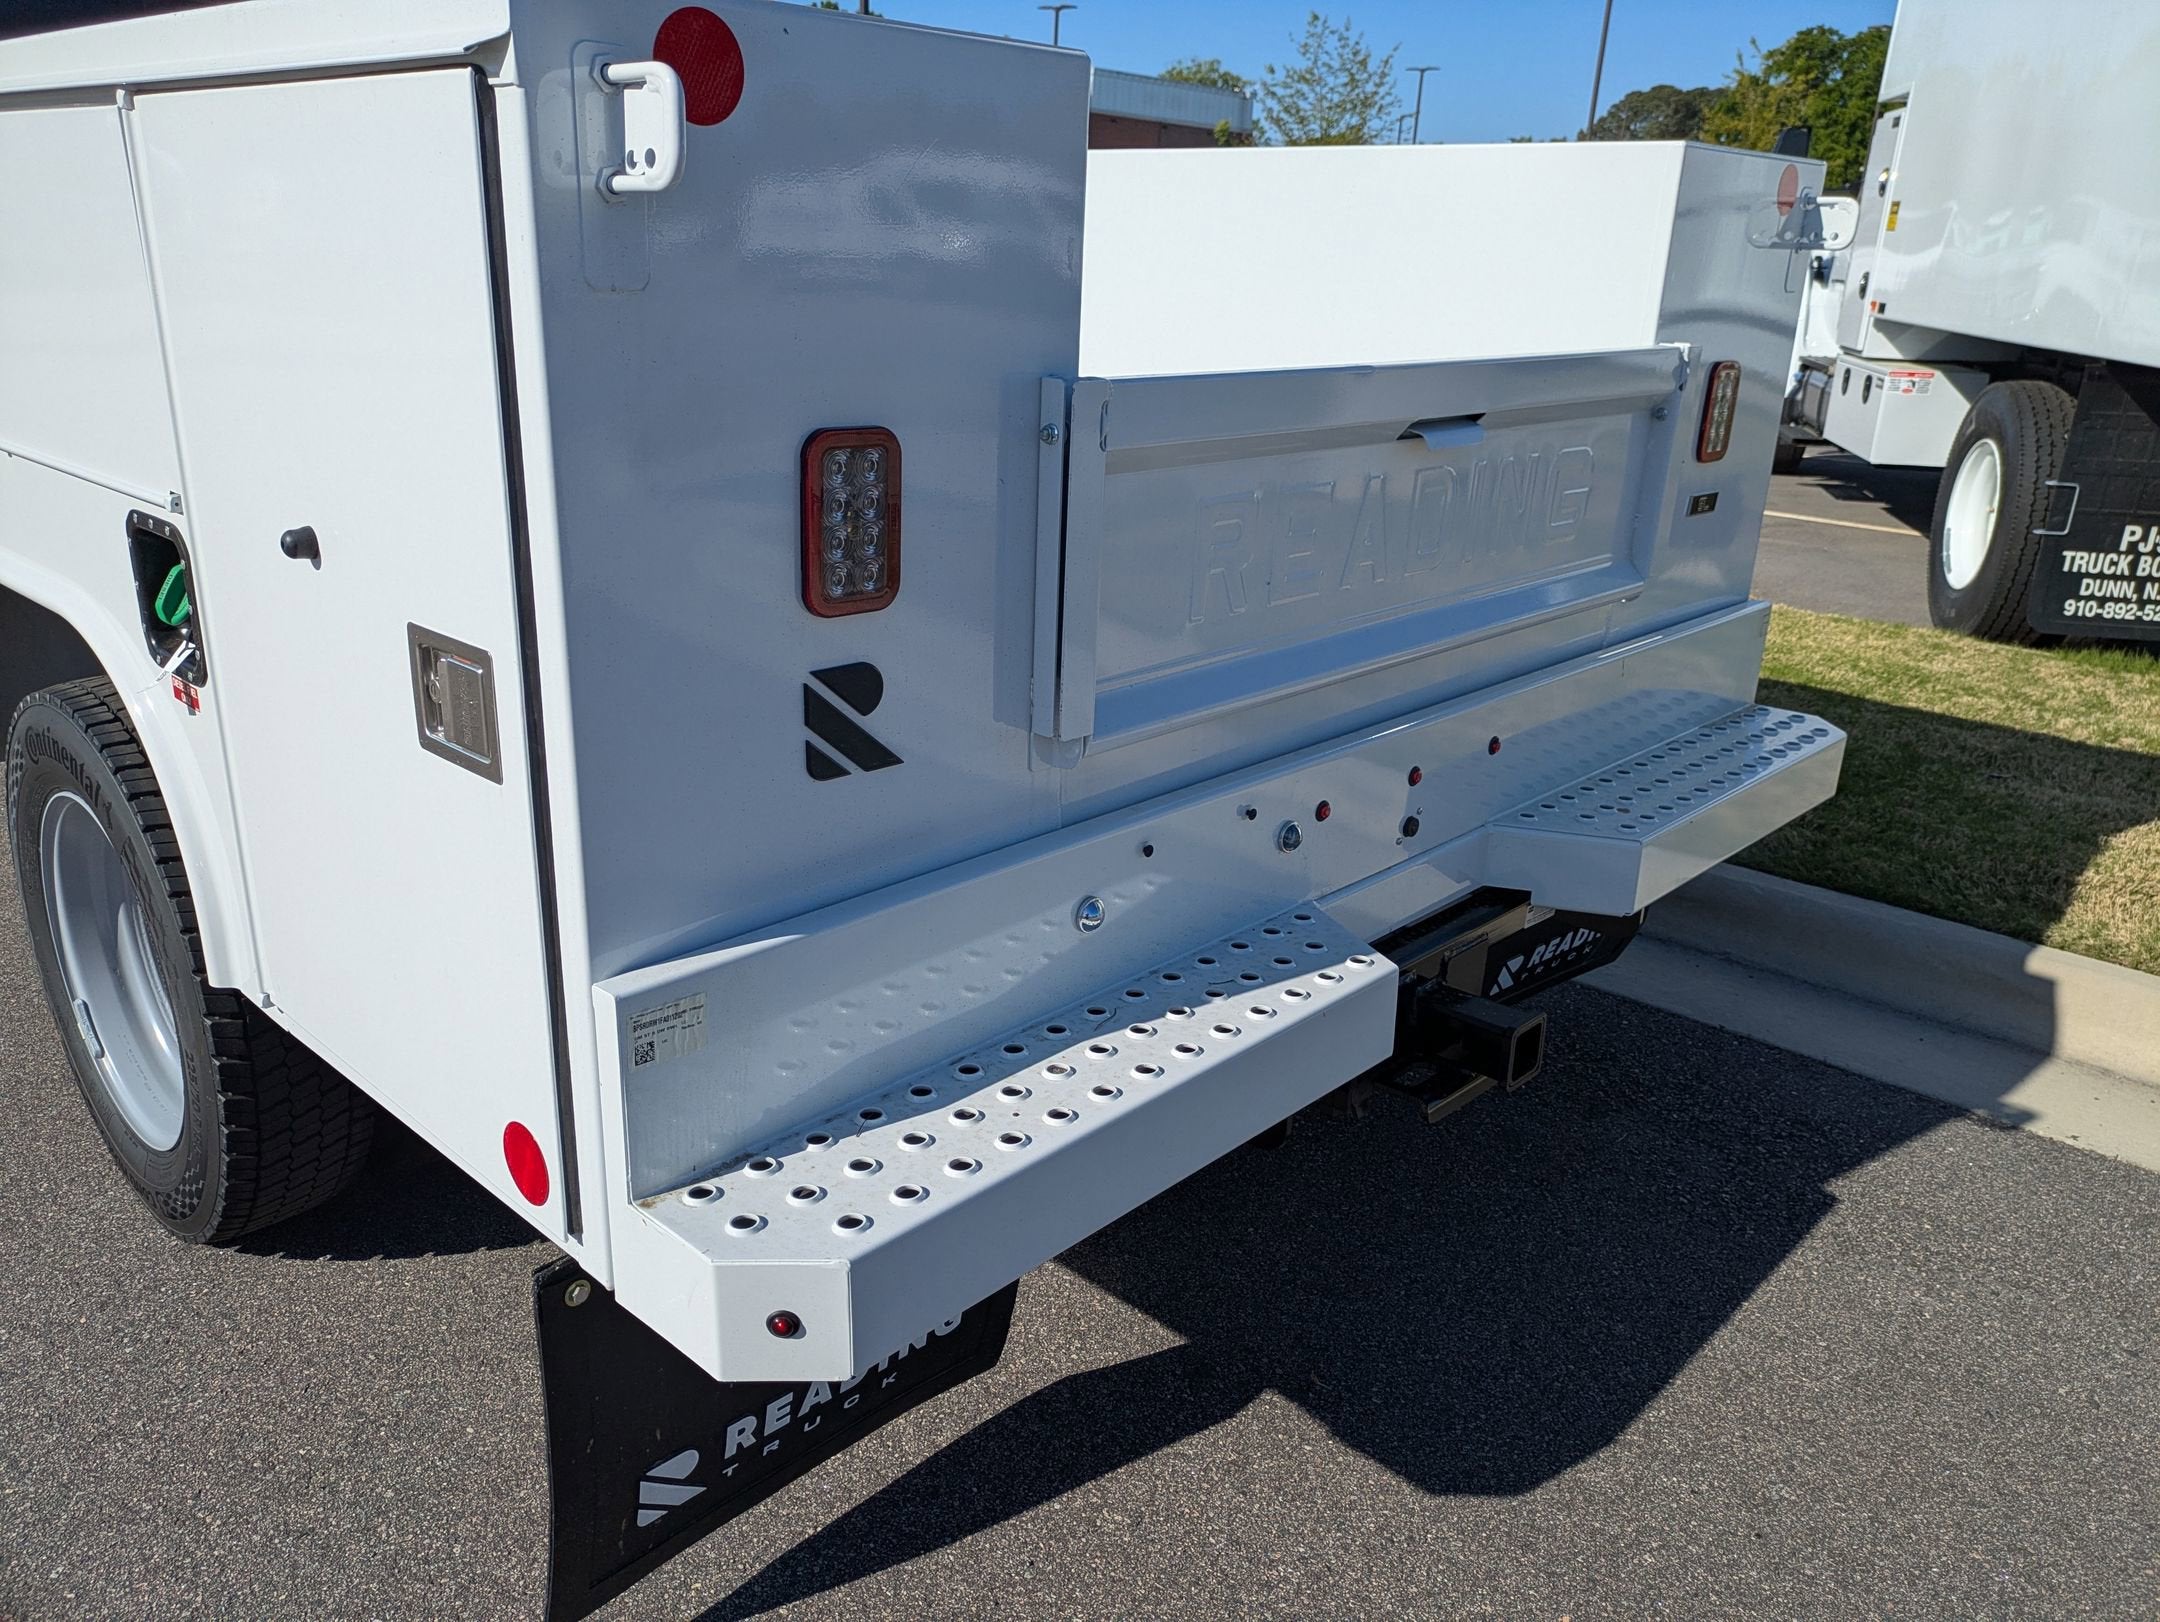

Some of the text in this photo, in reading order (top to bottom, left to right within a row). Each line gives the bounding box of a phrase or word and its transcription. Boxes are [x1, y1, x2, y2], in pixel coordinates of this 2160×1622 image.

[1187, 447, 1594, 627] READING
[2062, 551, 2134, 576] TRUCK
[2119, 525, 2160, 553] PJ'
[2079, 578, 2138, 603] DUNN,
[25, 725, 102, 808] Continental
[722, 1371, 897, 1477] TRUCK
